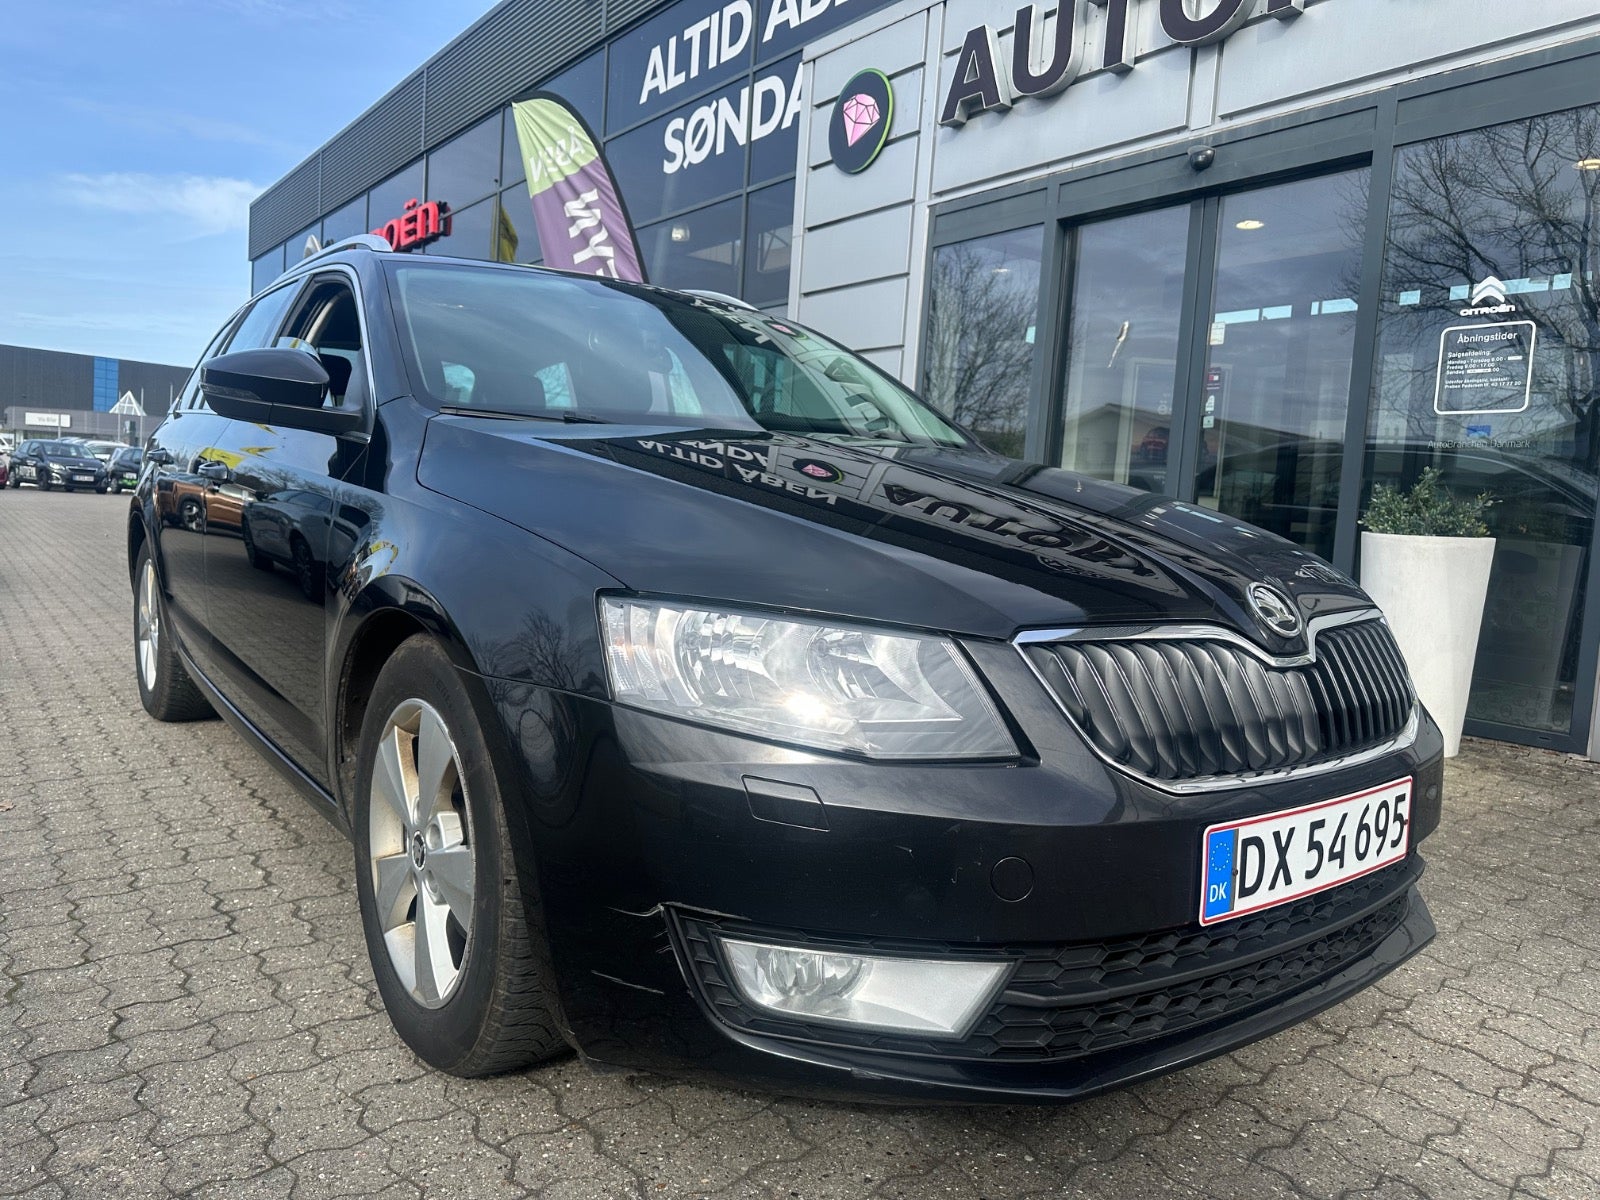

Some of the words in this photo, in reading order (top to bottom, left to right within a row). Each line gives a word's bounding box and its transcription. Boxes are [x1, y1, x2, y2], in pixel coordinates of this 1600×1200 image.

[639, 0, 753, 105] ALTID
[1457, 332, 1518, 344] Åbningstider
[1238, 826, 1296, 899] DX
[1209, 881, 1228, 903] DK
